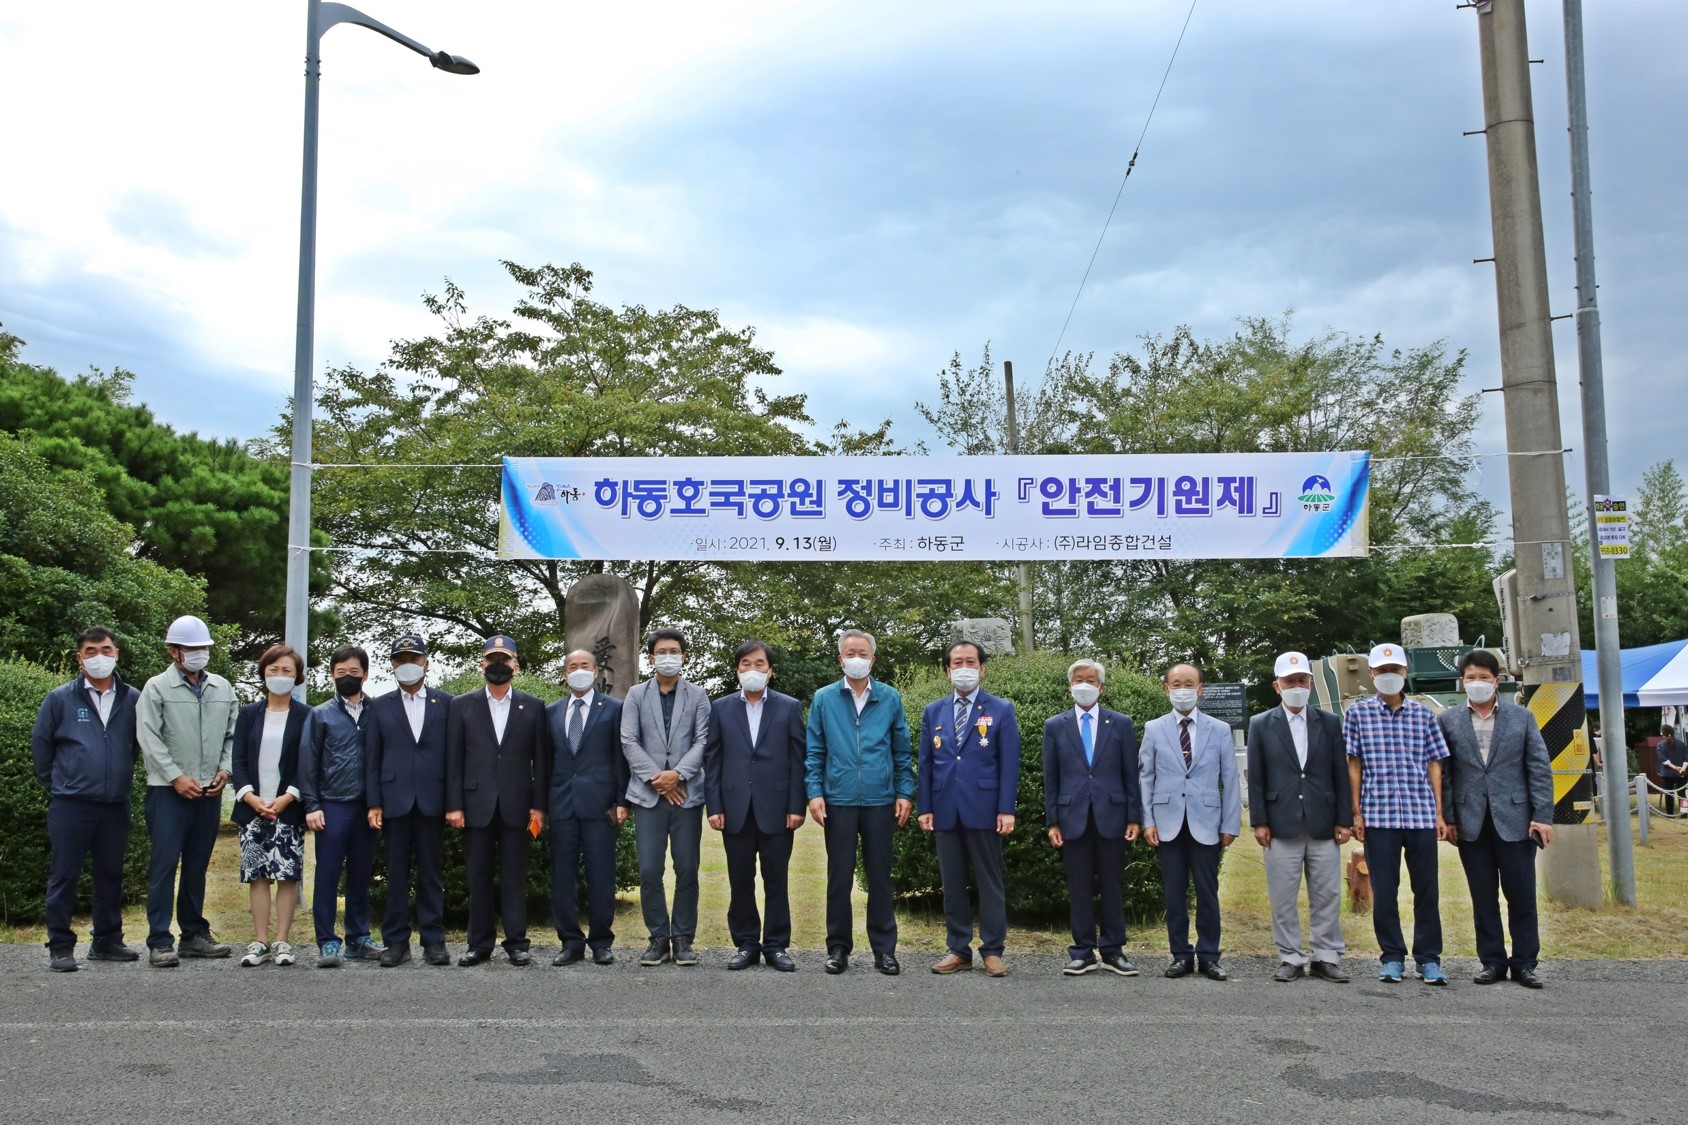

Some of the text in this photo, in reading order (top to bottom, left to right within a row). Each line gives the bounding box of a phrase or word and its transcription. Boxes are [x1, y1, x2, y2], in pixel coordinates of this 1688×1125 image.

[560, 487, 581, 504] 하동
[594, 477, 824, 519] 하동호국공원
[837, 478, 998, 519] 정비공사
[1303, 503, 1330, 512] 하동군
[917, 535, 965, 552] 하동군
[1053, 534, 1172, 551] (주)라임종합건설
